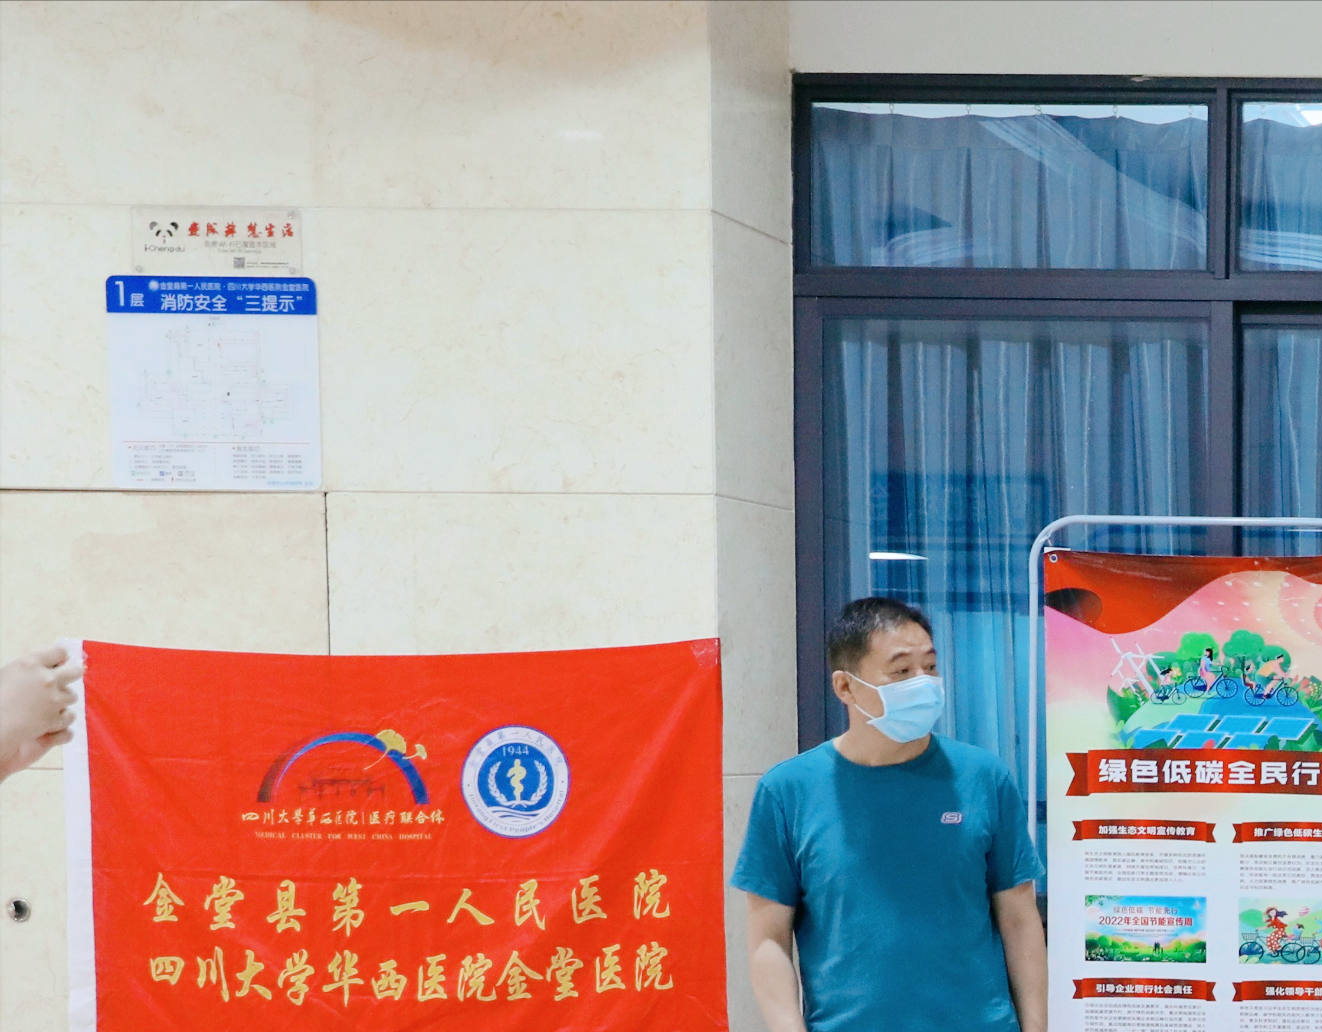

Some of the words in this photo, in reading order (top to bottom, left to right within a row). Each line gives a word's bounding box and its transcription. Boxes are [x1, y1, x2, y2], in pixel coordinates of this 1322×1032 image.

[160, 294, 227, 312] 消防安全
[502, 745, 529, 757] 1944
[1098, 824, 1196, 837] 加强生态文明宣传教育
[142, 868, 672, 937] 金堂县第一人民医院
[1113, 905, 1144, 915] 绿色低碳
[1148, 906, 1178, 915] 节能先行
[1098, 916, 1193, 927] 2022年全国节能宣传周
[148, 940, 674, 1008] 四川大学华西医院金堂医院
[1095, 982, 1193, 996] 引导企业履行社会责任
